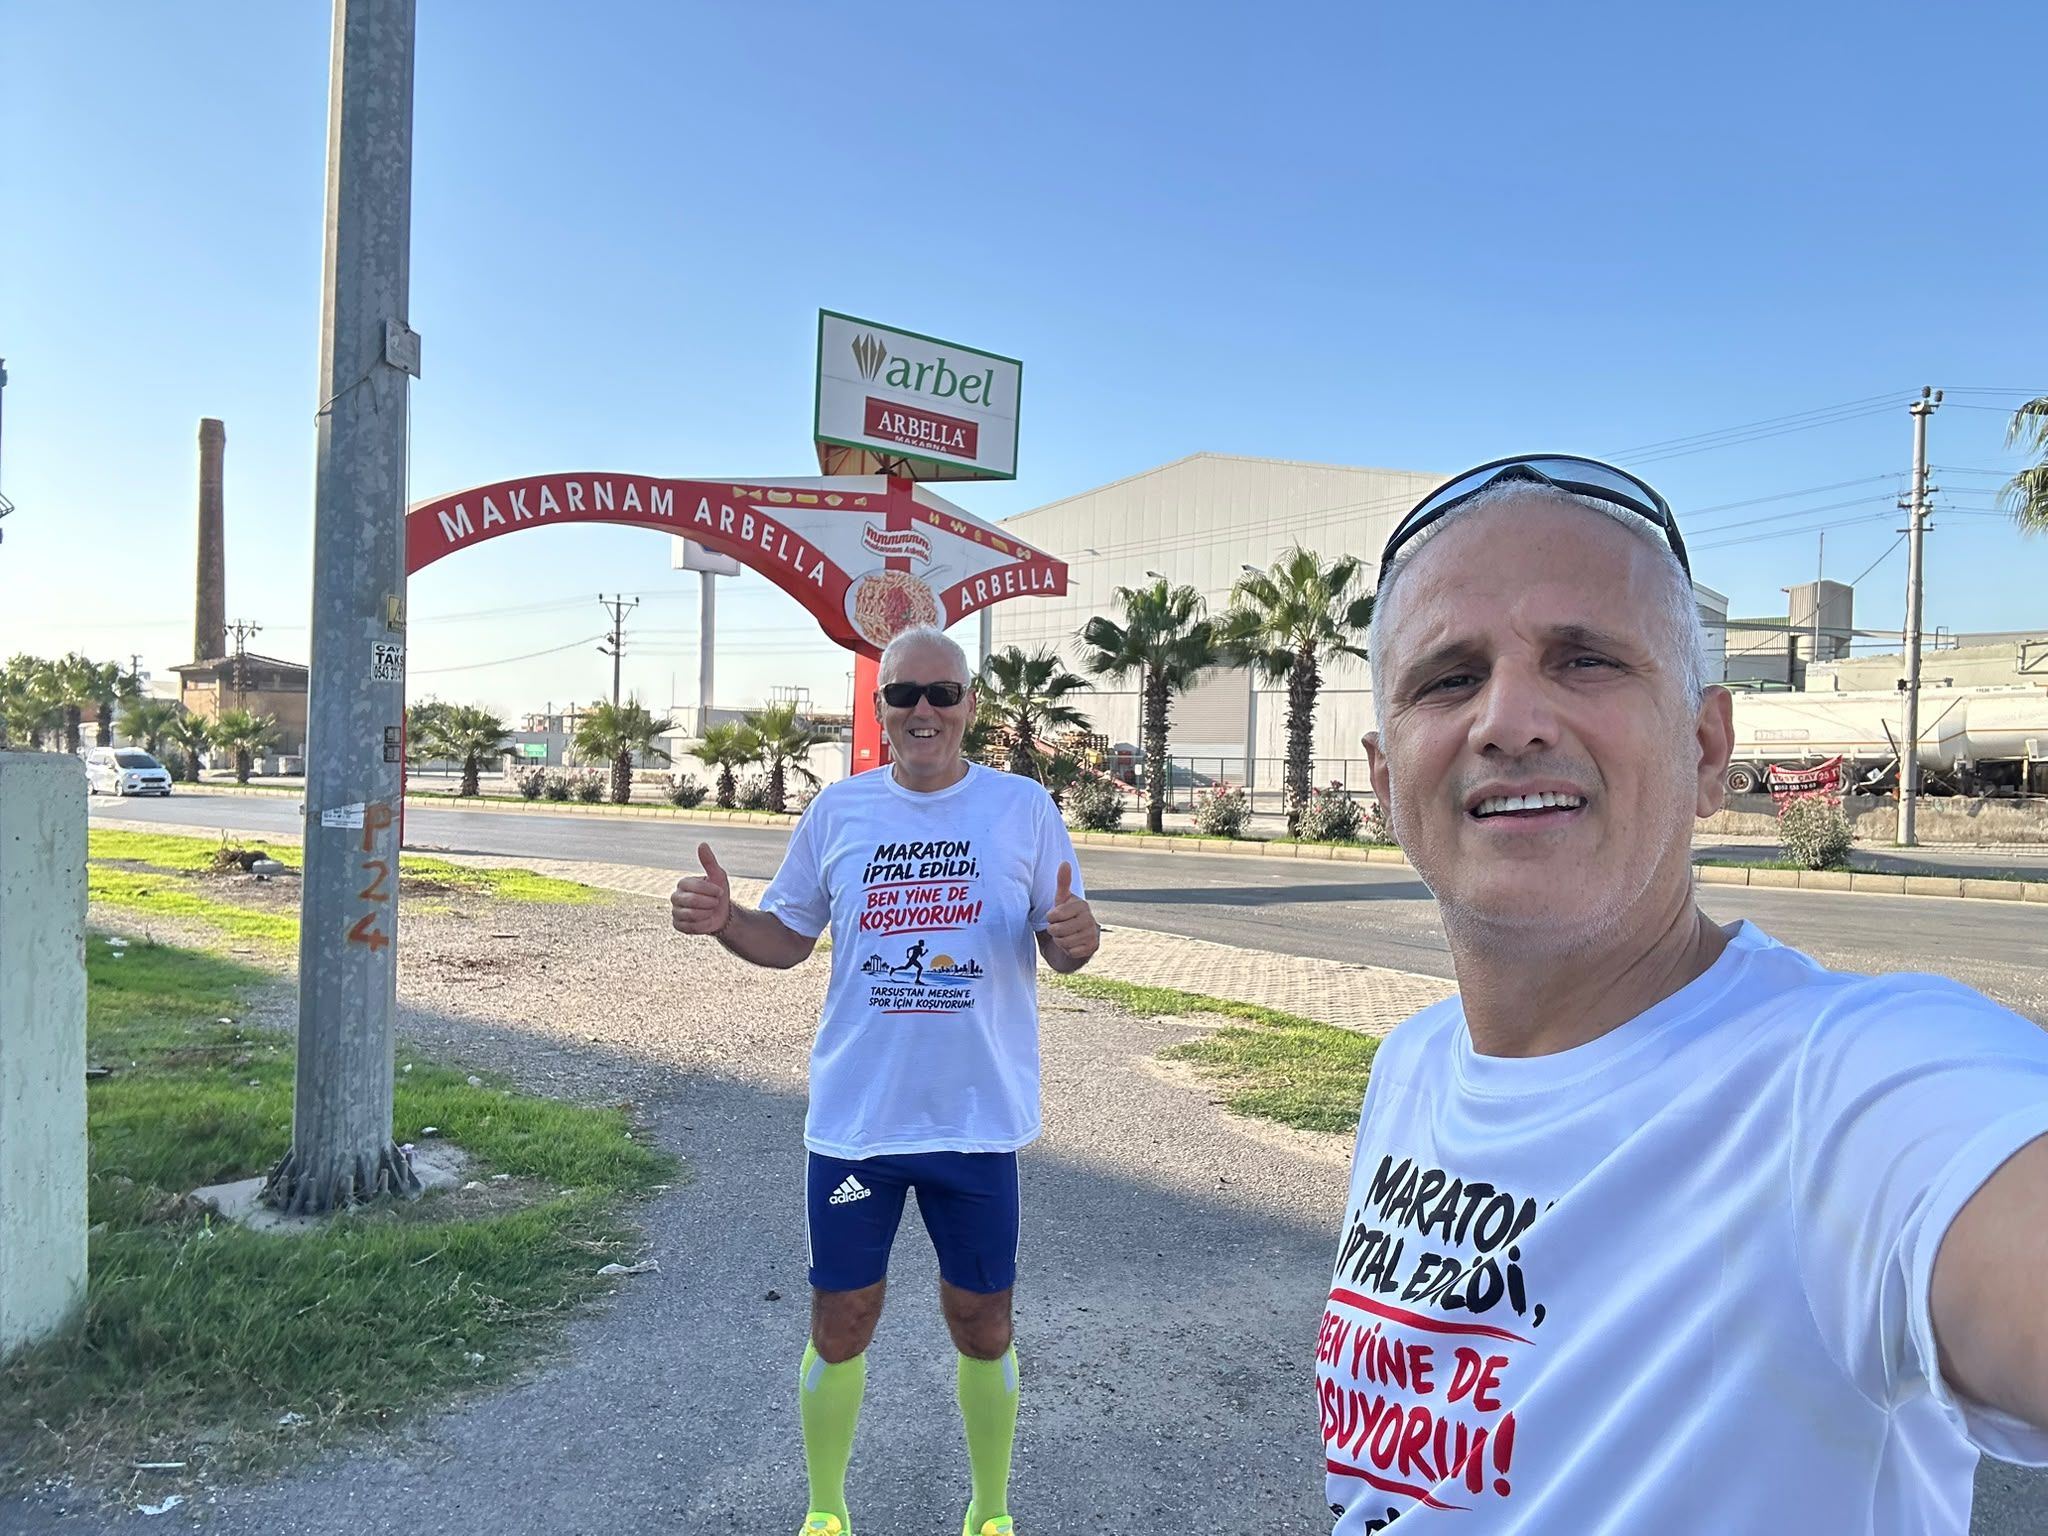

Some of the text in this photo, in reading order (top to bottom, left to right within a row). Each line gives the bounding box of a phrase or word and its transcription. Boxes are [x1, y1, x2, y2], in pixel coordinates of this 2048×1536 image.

[886, 357, 994, 407] arbel
[895, 436, 947, 453] MAKARNA
[437, 481, 825, 588] MAKARNAM ARBELLA
[960, 568, 1055, 611] ARBELLA
[874, 840, 970, 862] MARATON
[863, 857, 980, 884] İPTAL EDİLDİ,
[867, 886, 969, 909] BEN YİNE DE
[860, 900, 982, 932] KOŞUYORUM!
[869, 997, 975, 1010] SPOR İÇİN KOŞUYORUM!
[871, 986, 971, 998] TARSUS'TAN MERSİN'E
[829, 1188, 872, 1205] adidas
[1335, 1209, 1404, 1293] İPTAL
[1315, 1310, 1510, 1412] BEN YİNE DE
